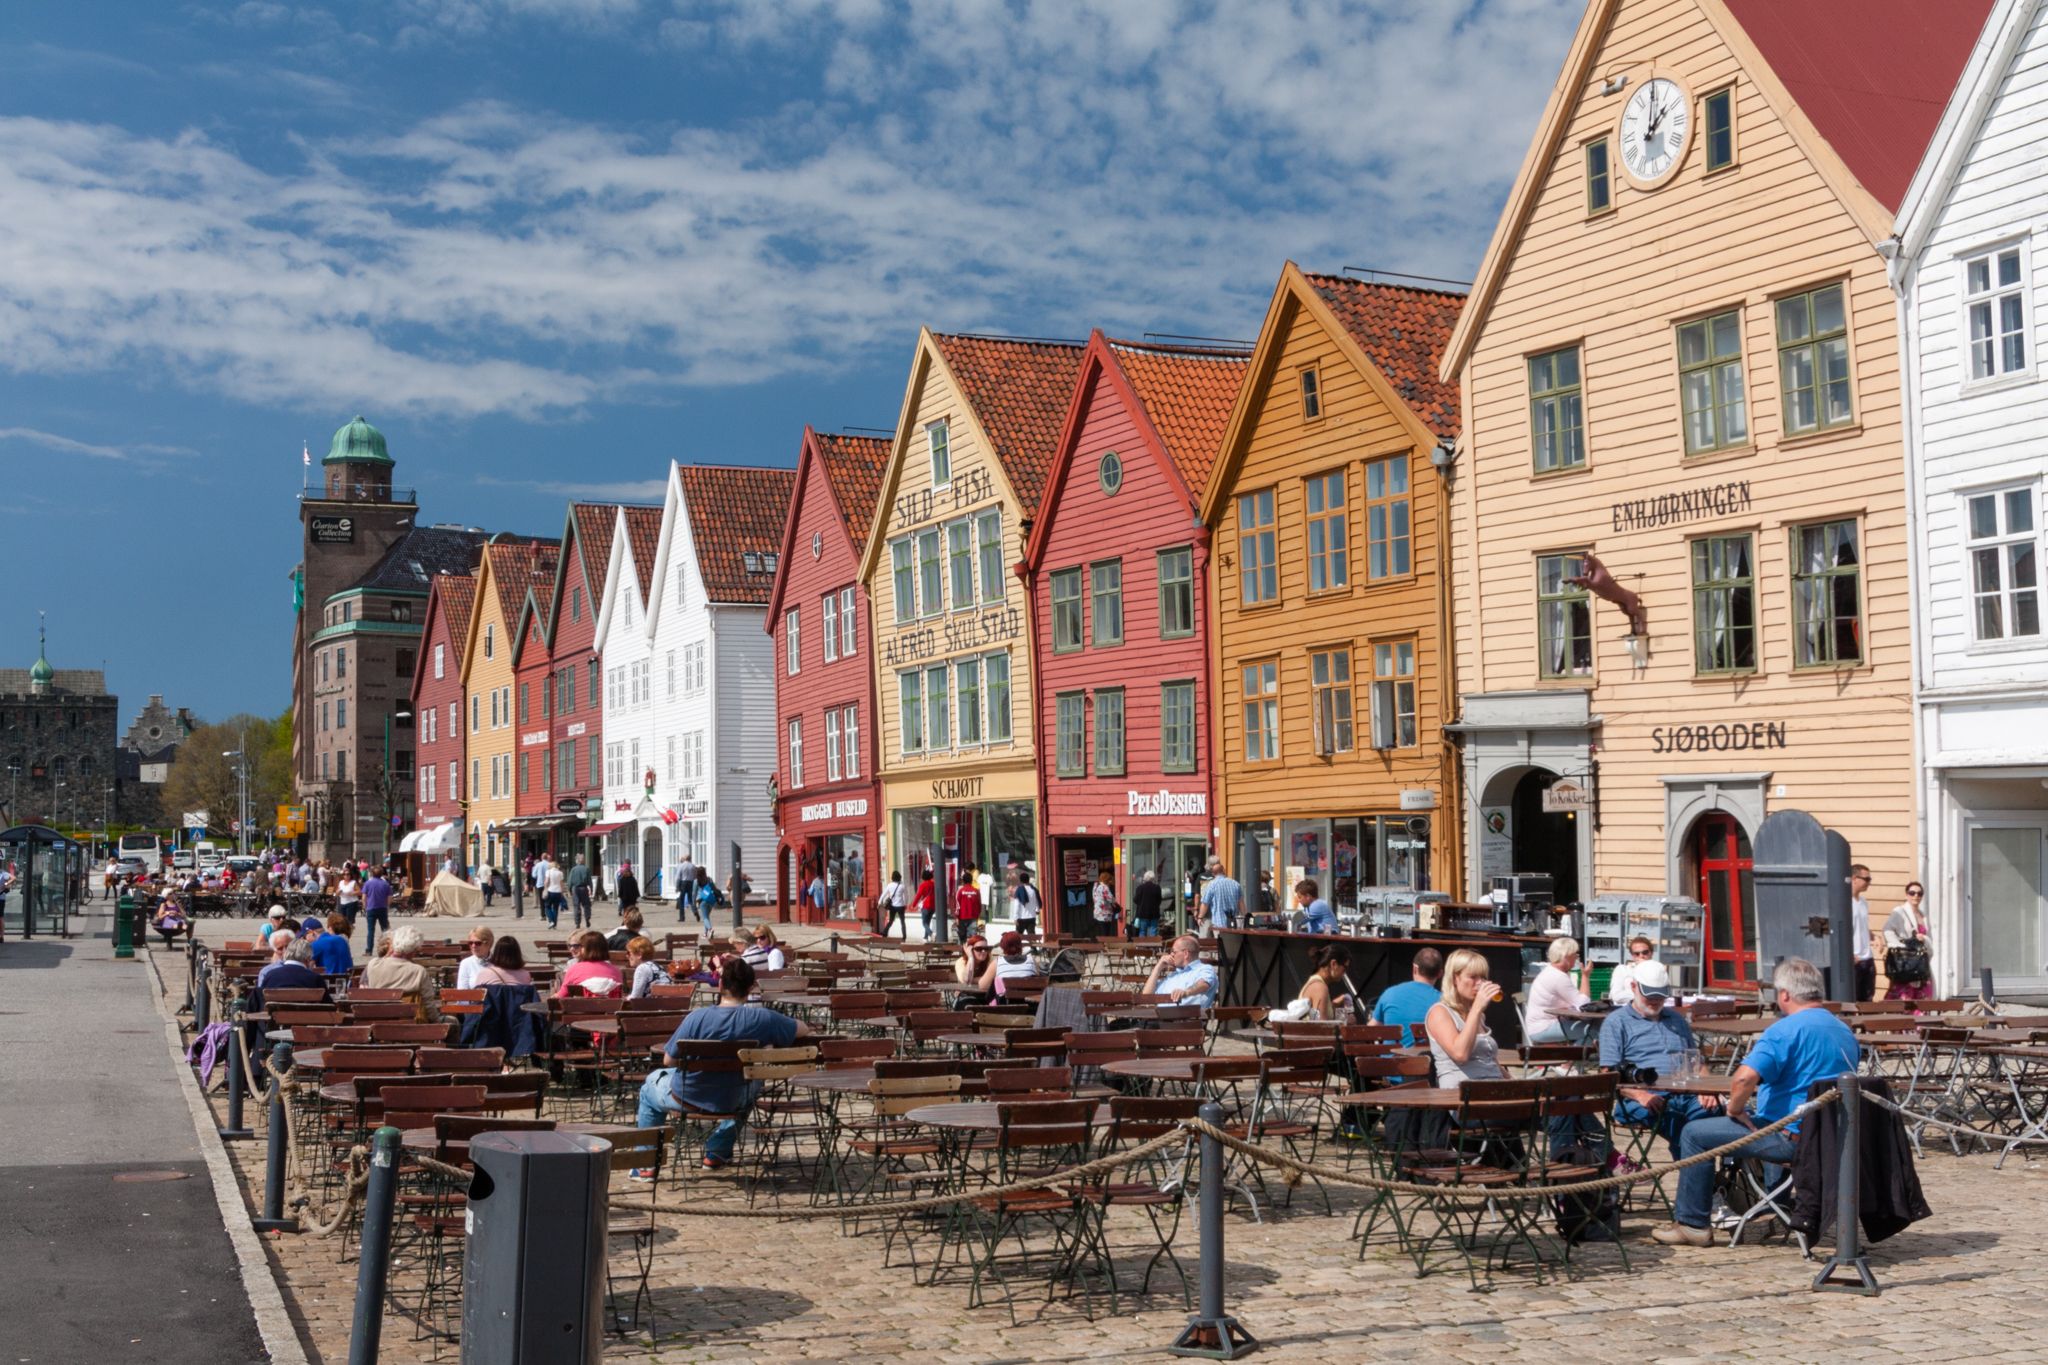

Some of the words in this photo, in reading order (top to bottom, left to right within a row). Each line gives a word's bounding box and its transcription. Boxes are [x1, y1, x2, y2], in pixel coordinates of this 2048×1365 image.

[897, 488, 933, 530] SILD
[952, 466, 994, 510] FISK
[1612, 480, 1751, 533] ENHJØRNINGEN
[886, 628, 935, 666] ALFRED
[1652, 721, 1787, 754] SJØBODEN
[932, 776, 984, 800] SCHJØTT
